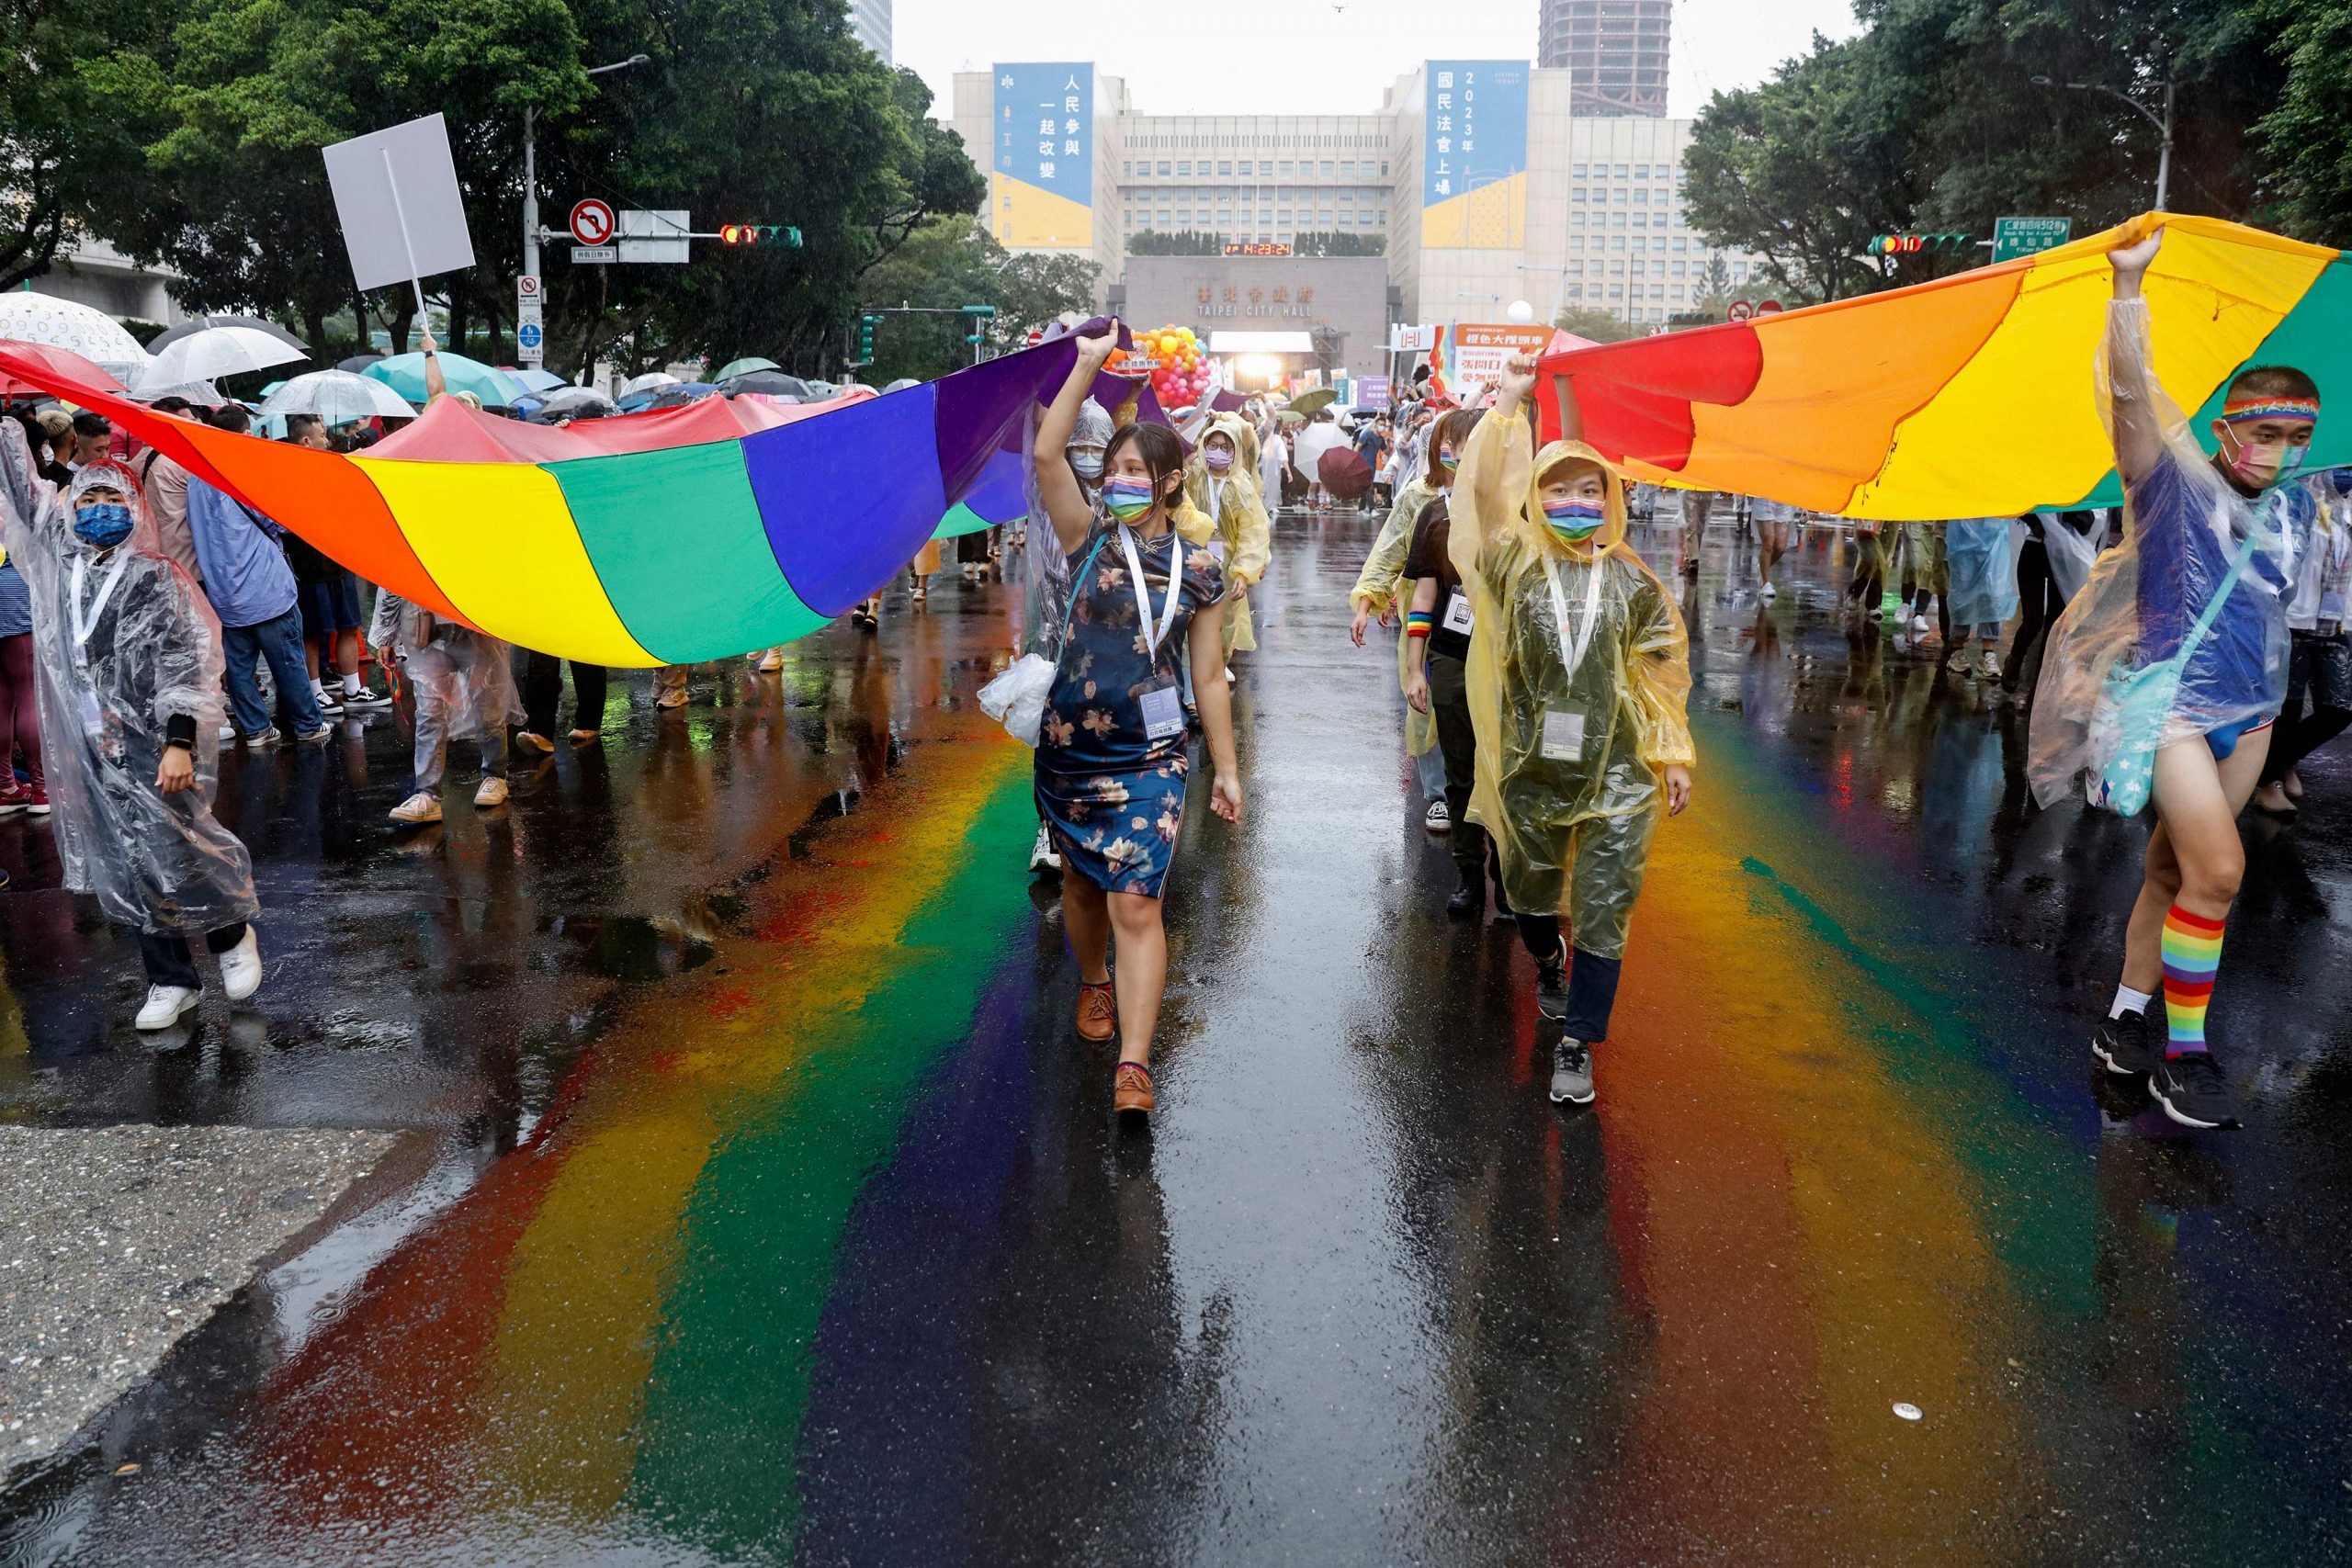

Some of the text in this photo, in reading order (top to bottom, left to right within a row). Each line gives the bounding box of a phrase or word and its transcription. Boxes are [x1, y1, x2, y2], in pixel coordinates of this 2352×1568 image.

[1039, 102, 1056, 178] 一起改變
[1064, 73, 1080, 156] 人民參與
[1435, 72, 1453, 195] 國民法官上場
[1461, 72, 1474, 152] 2023年
[1244, 243, 1290, 254] 14:23:24
[1198, 306, 1312, 317] TAIPEI CITY HALL
